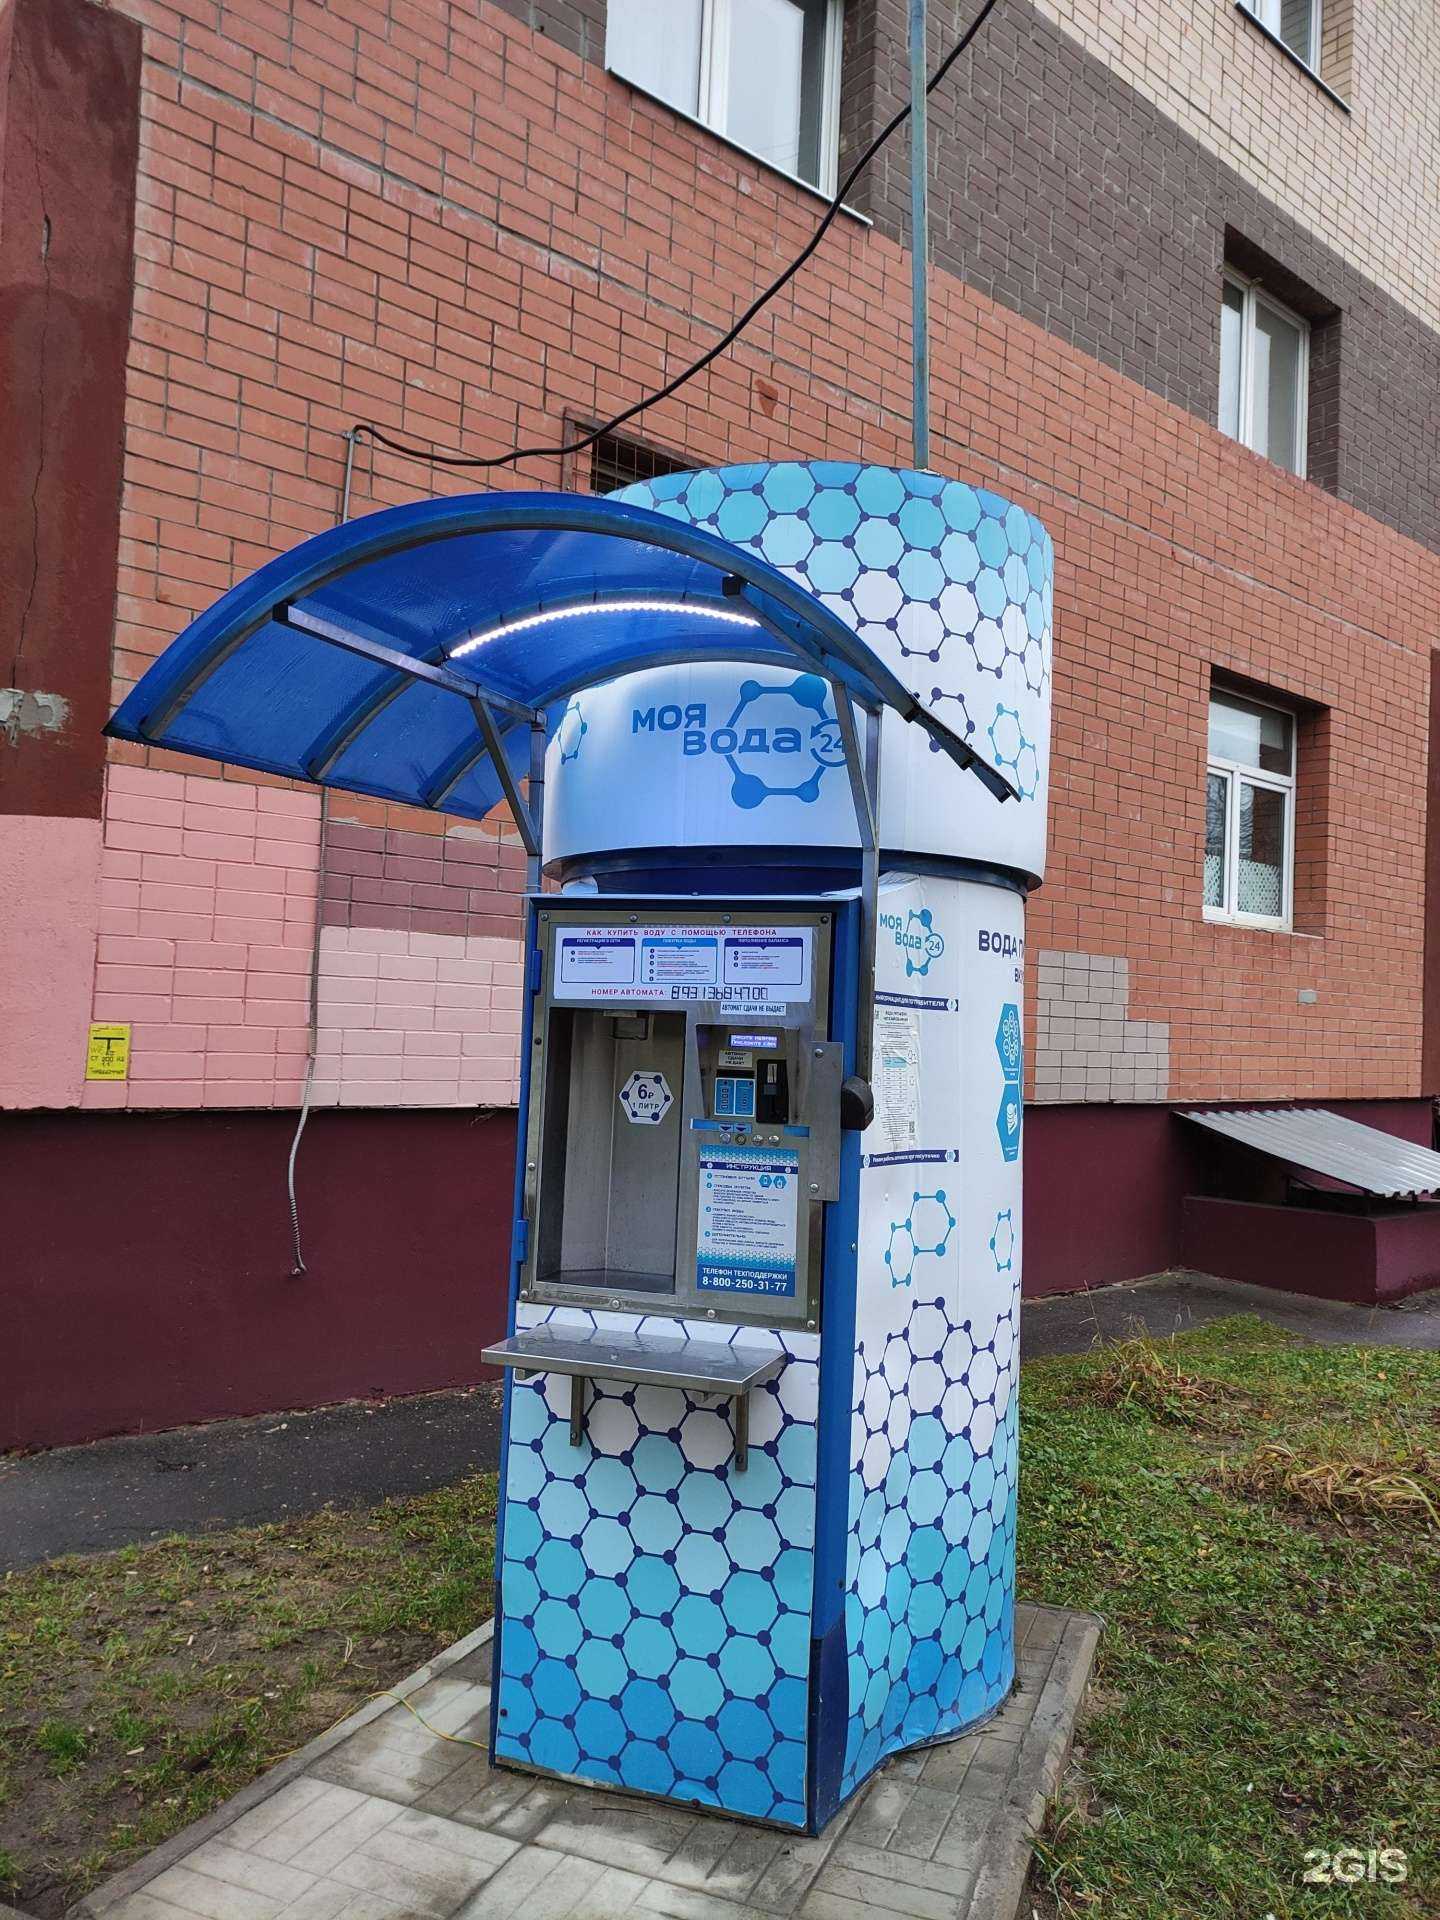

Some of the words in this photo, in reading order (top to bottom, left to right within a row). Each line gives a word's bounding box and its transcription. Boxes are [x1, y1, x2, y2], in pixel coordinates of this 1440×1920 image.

[586, 929, 604, 937] КАК
[607, 929, 639, 937] КУПИТЬ
[644, 929, 666, 937] ВОДУ
[671, 929, 676, 937] С
[681, 929, 727, 938] ПОМОЩЬЮ
[732, 929, 777, 937] ТЕЛЕФОНА
[929, 939, 941, 952] 24
[978, 929, 1017, 959] ВОДА
[591, 989, 619, 997] НОМЕР
[721, 1004, 742, 1012] АВТОМАТ
[743, 1005, 758, 1013] СДАЧИ
[766, 1005, 785, 1014] ВЫДАЕТ
[638, 1102, 660, 1110] ЛИТР
[726, 1163, 772, 1172] ИНСТРУКЦИЯ
[702, 1267, 733, 1276] ТЕЛЕФОН
[734, 1269, 788, 1280] ТЕХПОДДЕРЖКИ
[702, 1276, 788, 1292] 8-800-250-31-77
